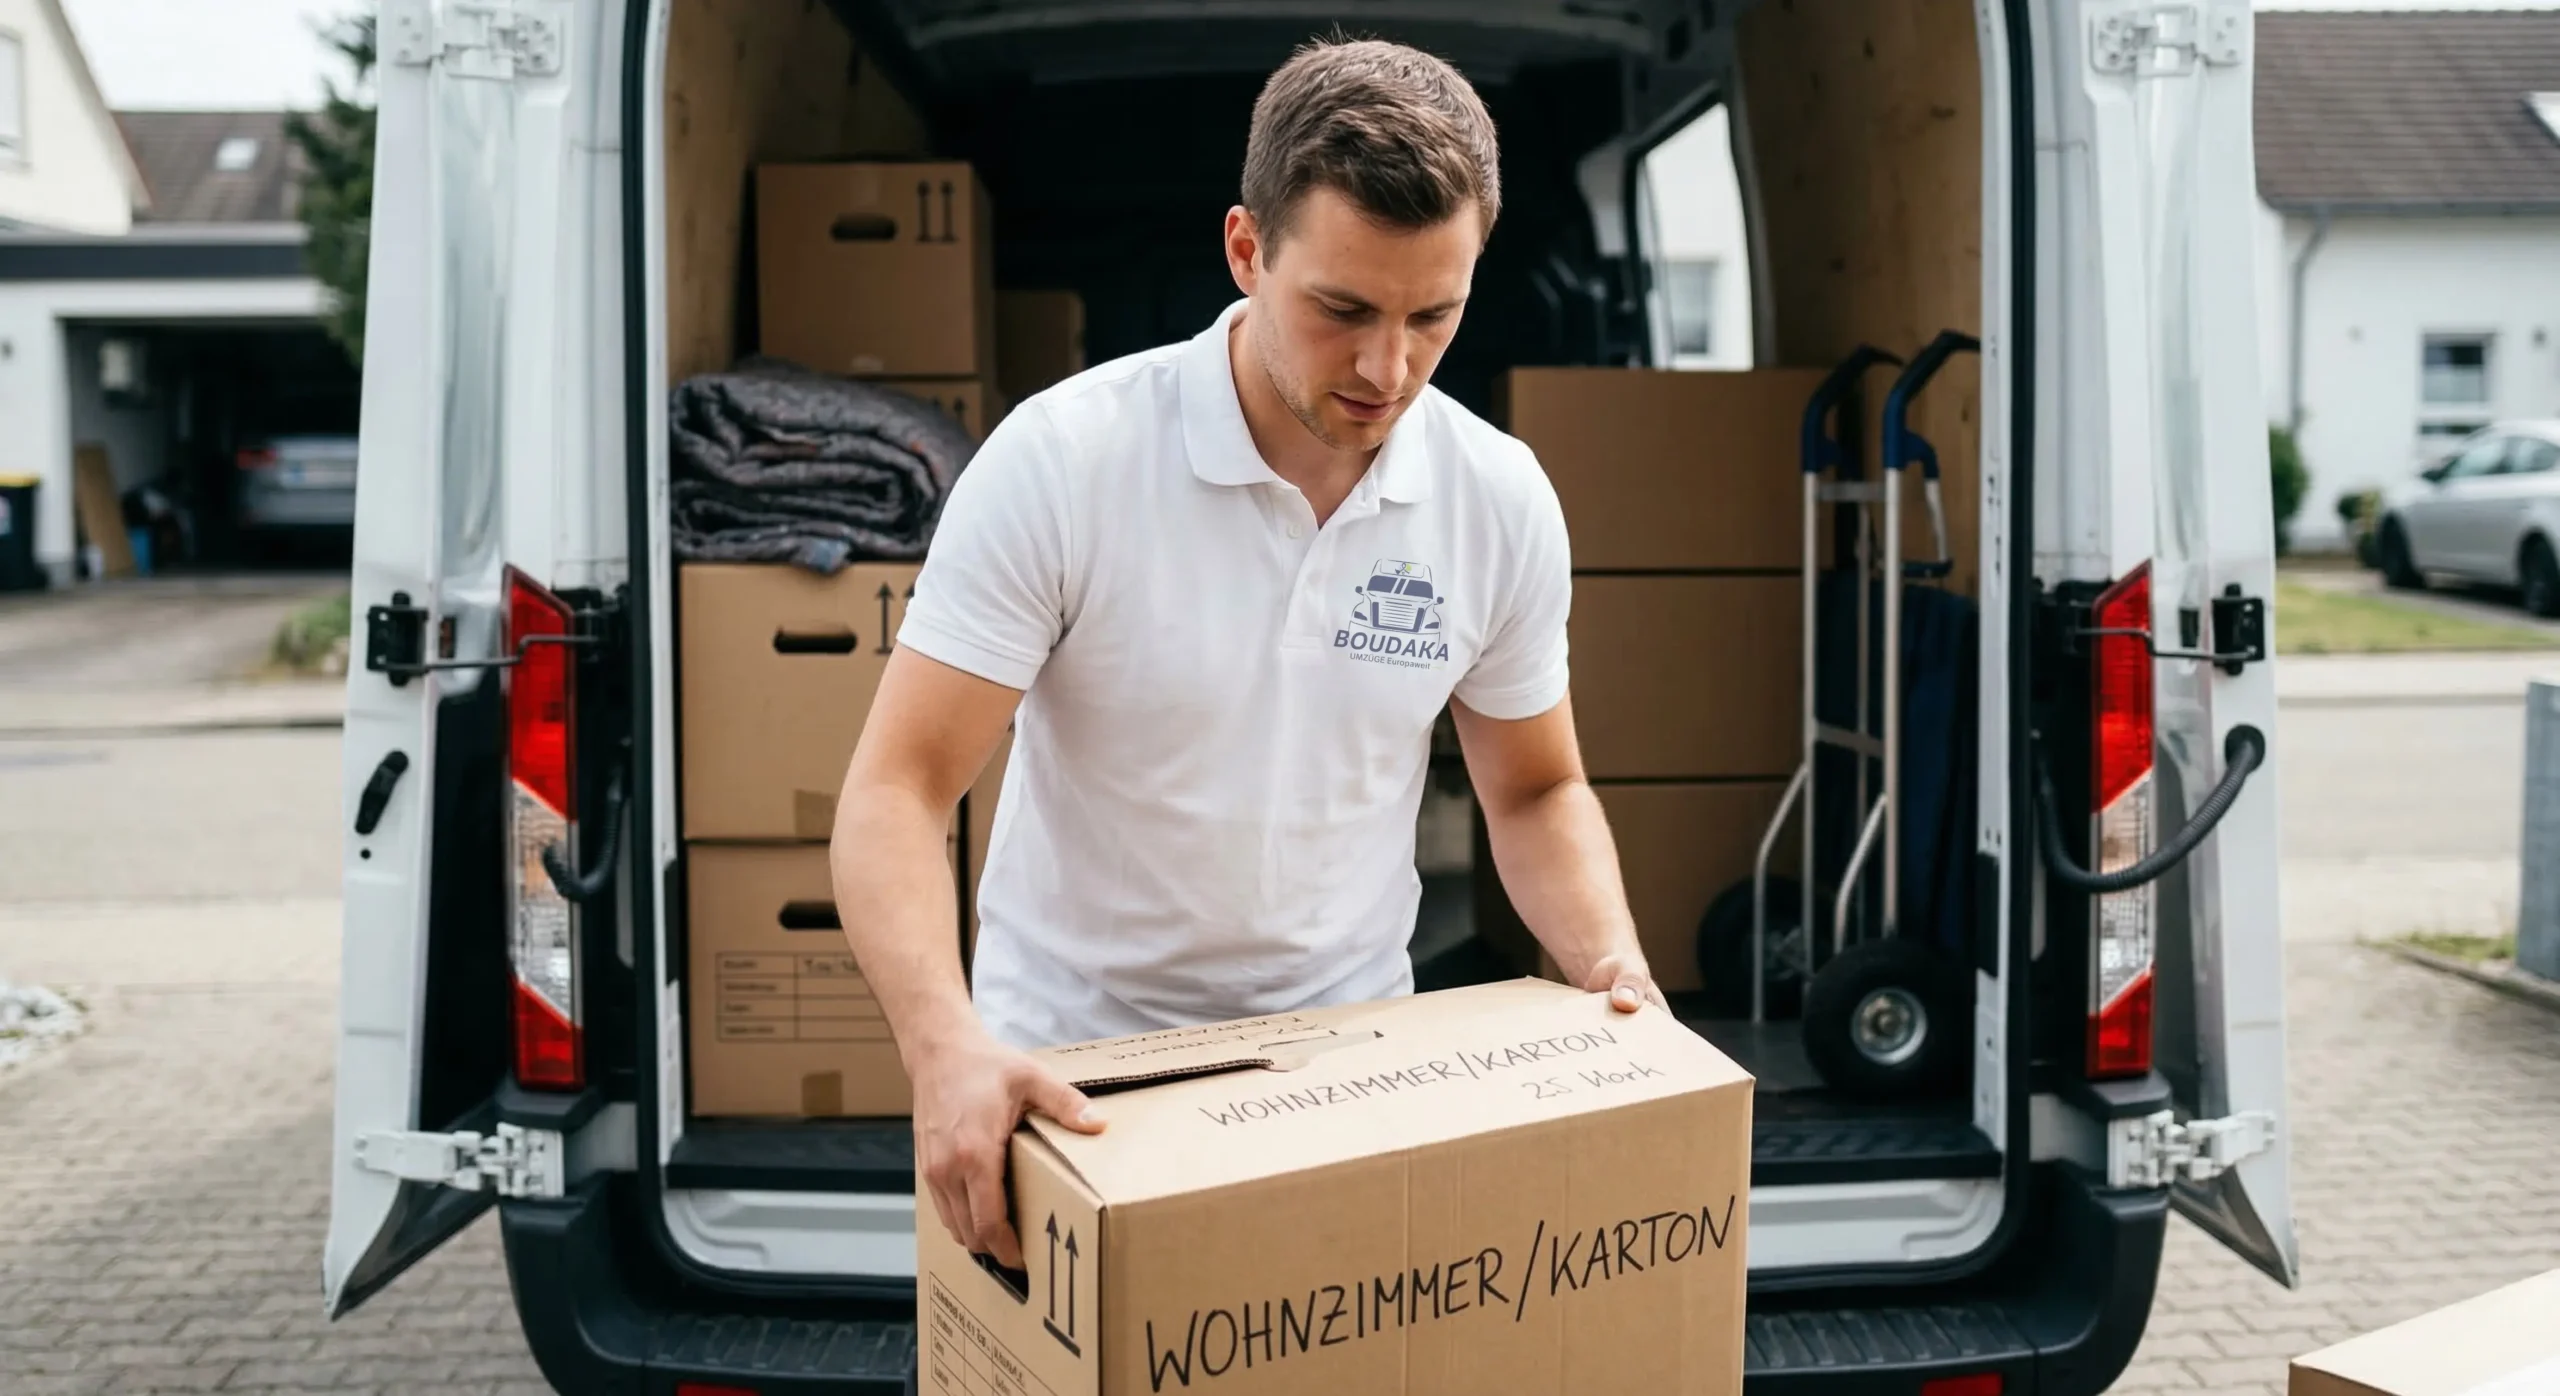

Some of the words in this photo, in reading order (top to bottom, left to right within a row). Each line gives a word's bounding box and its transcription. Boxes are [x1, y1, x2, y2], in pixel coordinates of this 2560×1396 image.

[1334, 629, 1449, 661] BOUDAKA
[1349, 652, 1385, 664] UMZÜGE
[1386, 657, 1431, 670] Europaweit
[1198, 1027, 1617, 1127] WOHNZIMMER/KARTON
[1146, 1195, 1735, 1393] WOHNZIMMER/KARTON
